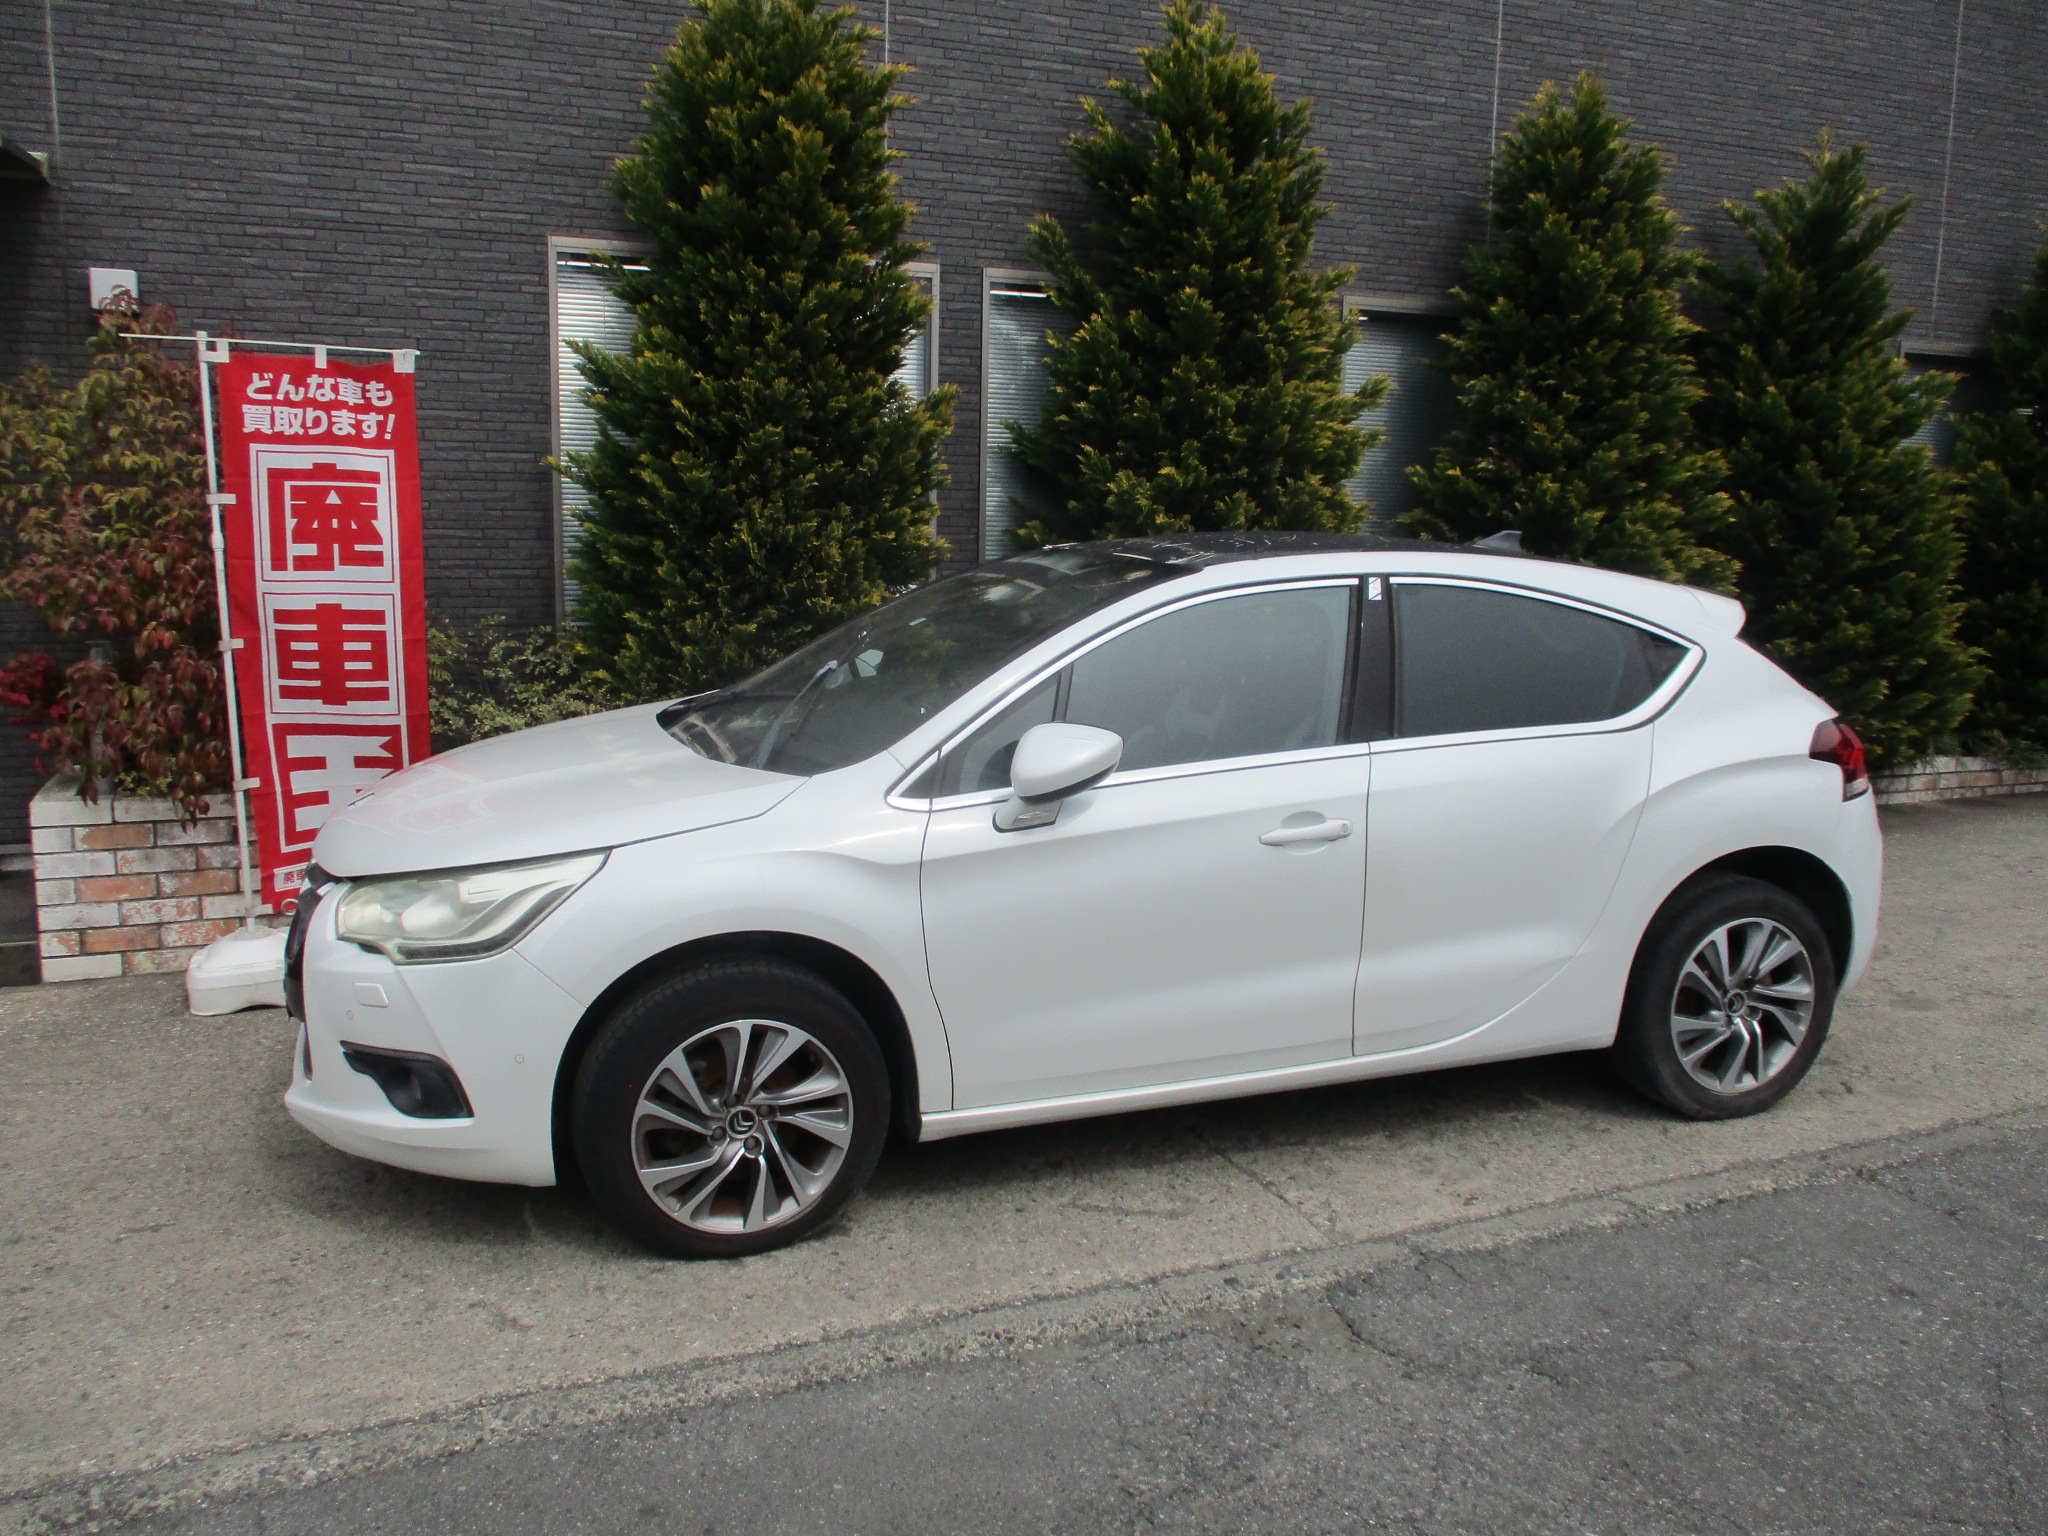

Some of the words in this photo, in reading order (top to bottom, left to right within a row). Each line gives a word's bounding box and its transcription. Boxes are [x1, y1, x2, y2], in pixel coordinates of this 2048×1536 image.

[246, 372, 393, 407] どんな車も
[242, 404, 396, 440] 買取ります!
